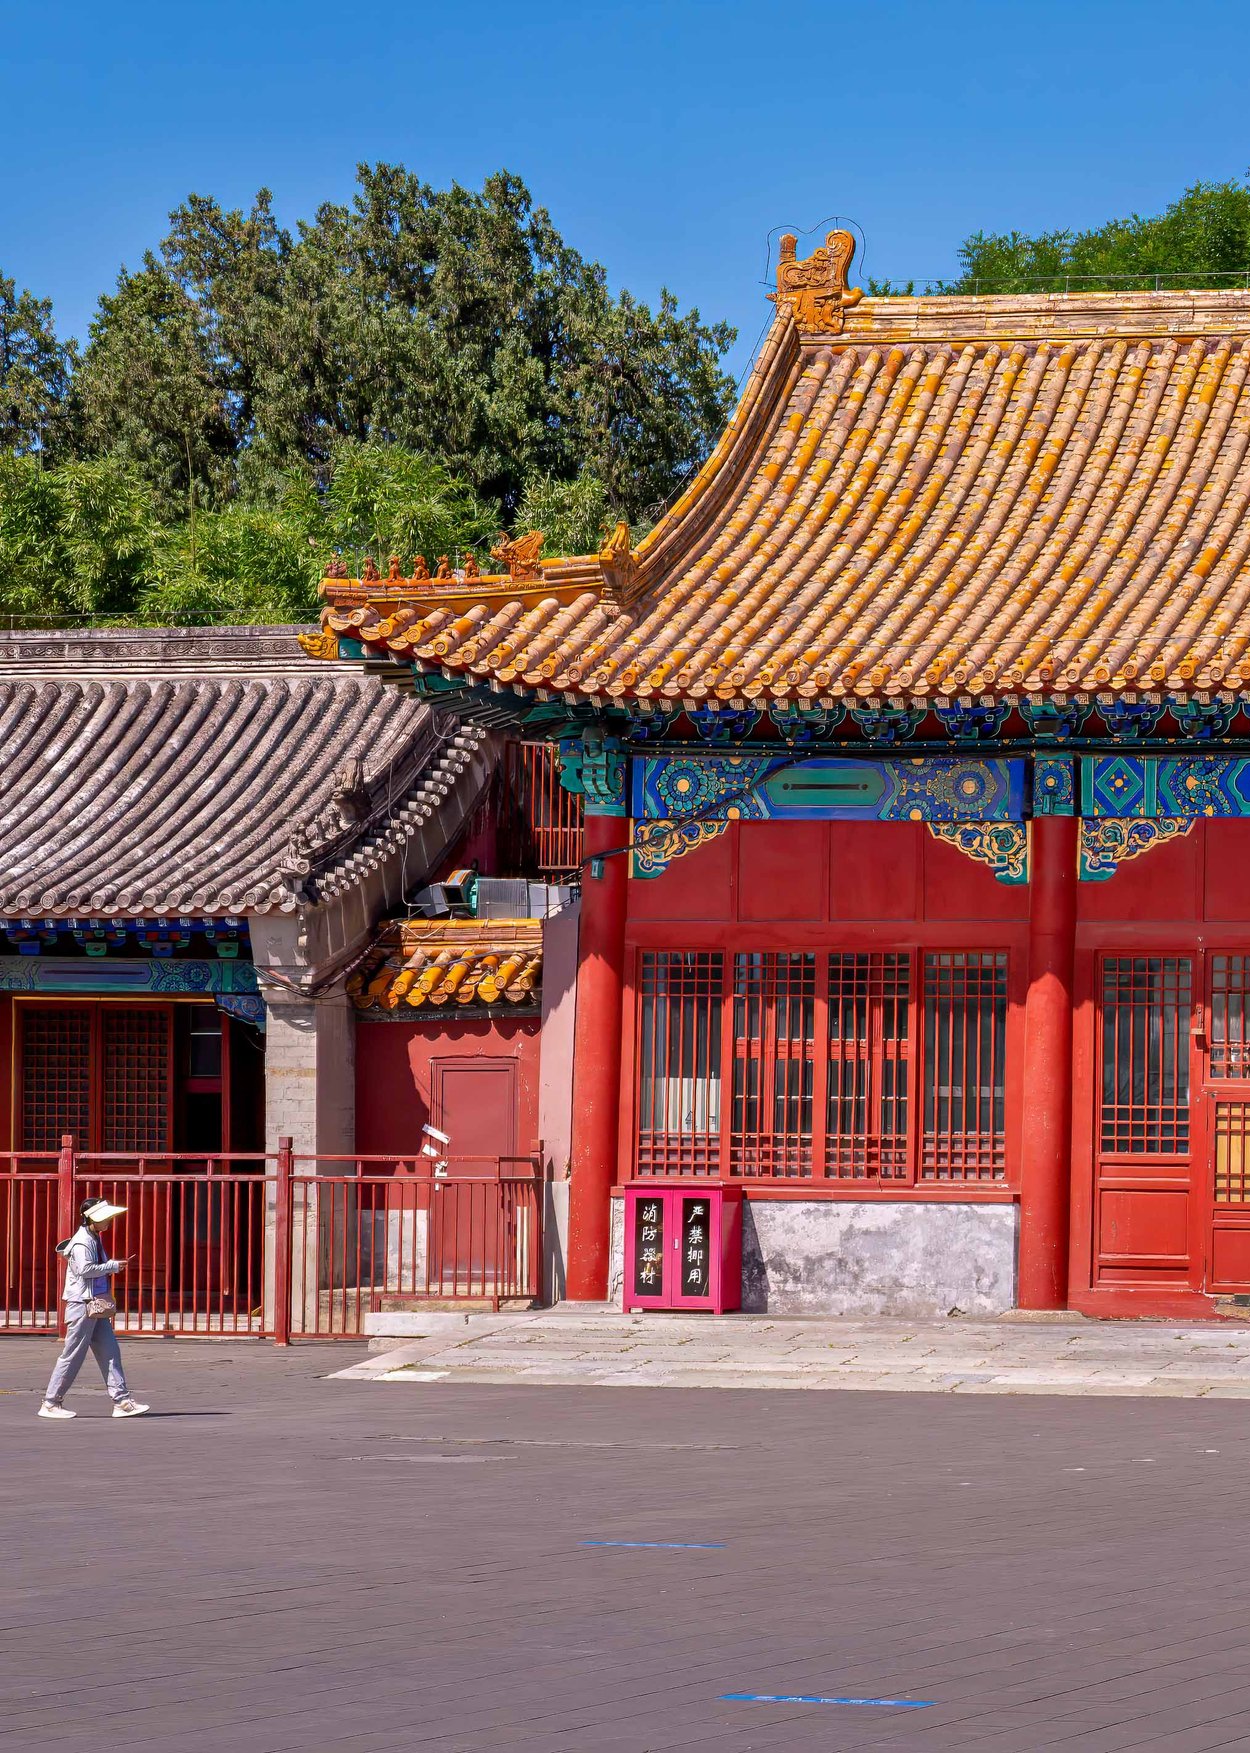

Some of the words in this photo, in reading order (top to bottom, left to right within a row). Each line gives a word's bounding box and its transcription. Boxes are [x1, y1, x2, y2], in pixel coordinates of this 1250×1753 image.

[641, 1203, 657, 1284] 消防器材
[687, 1205, 704, 1284] 严禁挪用
